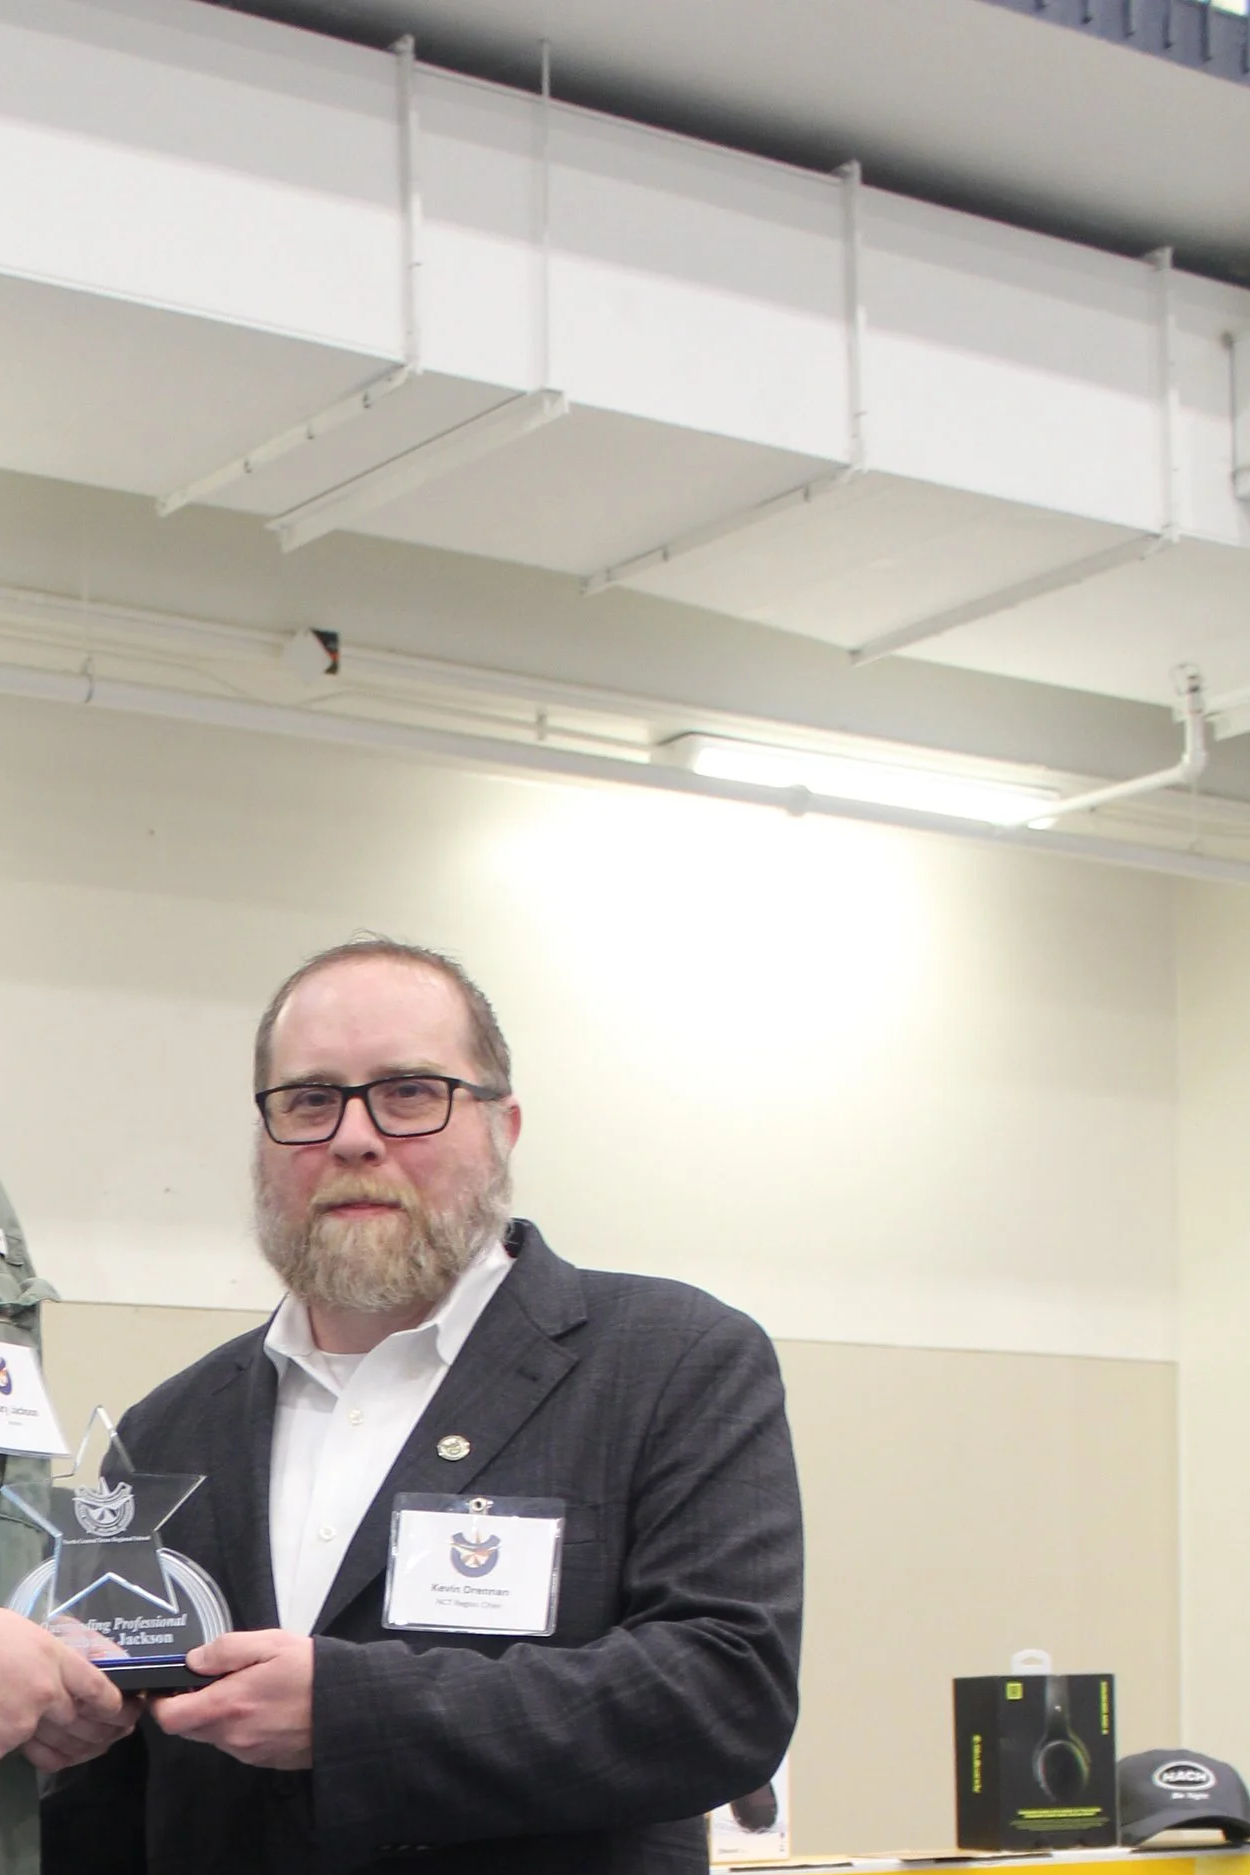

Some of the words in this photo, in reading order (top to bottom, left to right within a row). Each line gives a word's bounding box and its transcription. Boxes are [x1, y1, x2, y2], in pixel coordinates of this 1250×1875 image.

[430, 1583, 460, 1593] Kevin
[113, 1613, 188, 1633] Professional
[117, 1632, 174, 1646] Jackson
